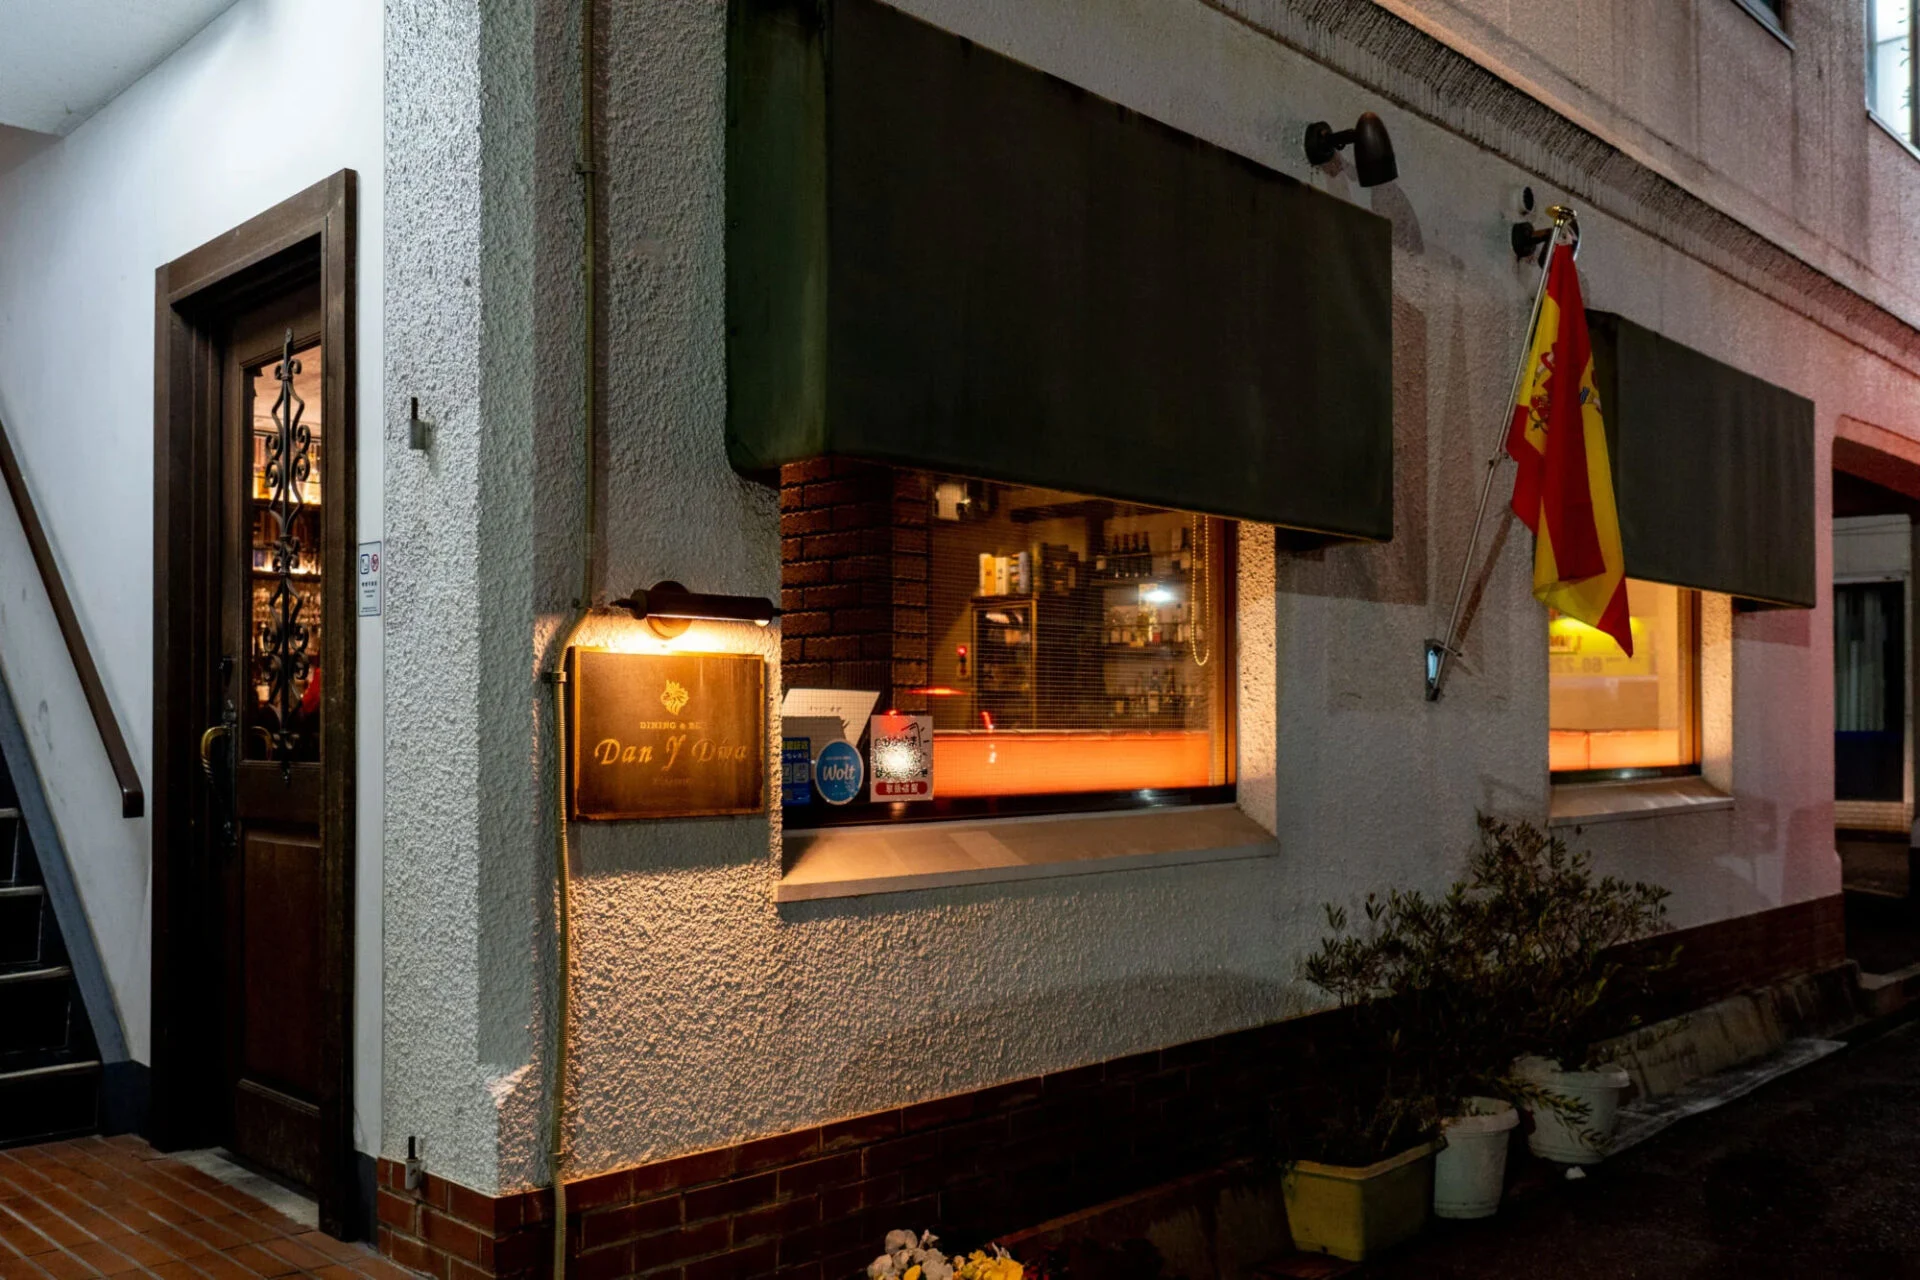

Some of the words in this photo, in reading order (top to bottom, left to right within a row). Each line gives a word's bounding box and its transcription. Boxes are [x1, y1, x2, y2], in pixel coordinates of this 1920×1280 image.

[640, 721, 677, 730] DINING
[594, 738, 653, 765] Dan
[660, 733, 687, 772] Y
[822, 763, 856, 782] Wolt
